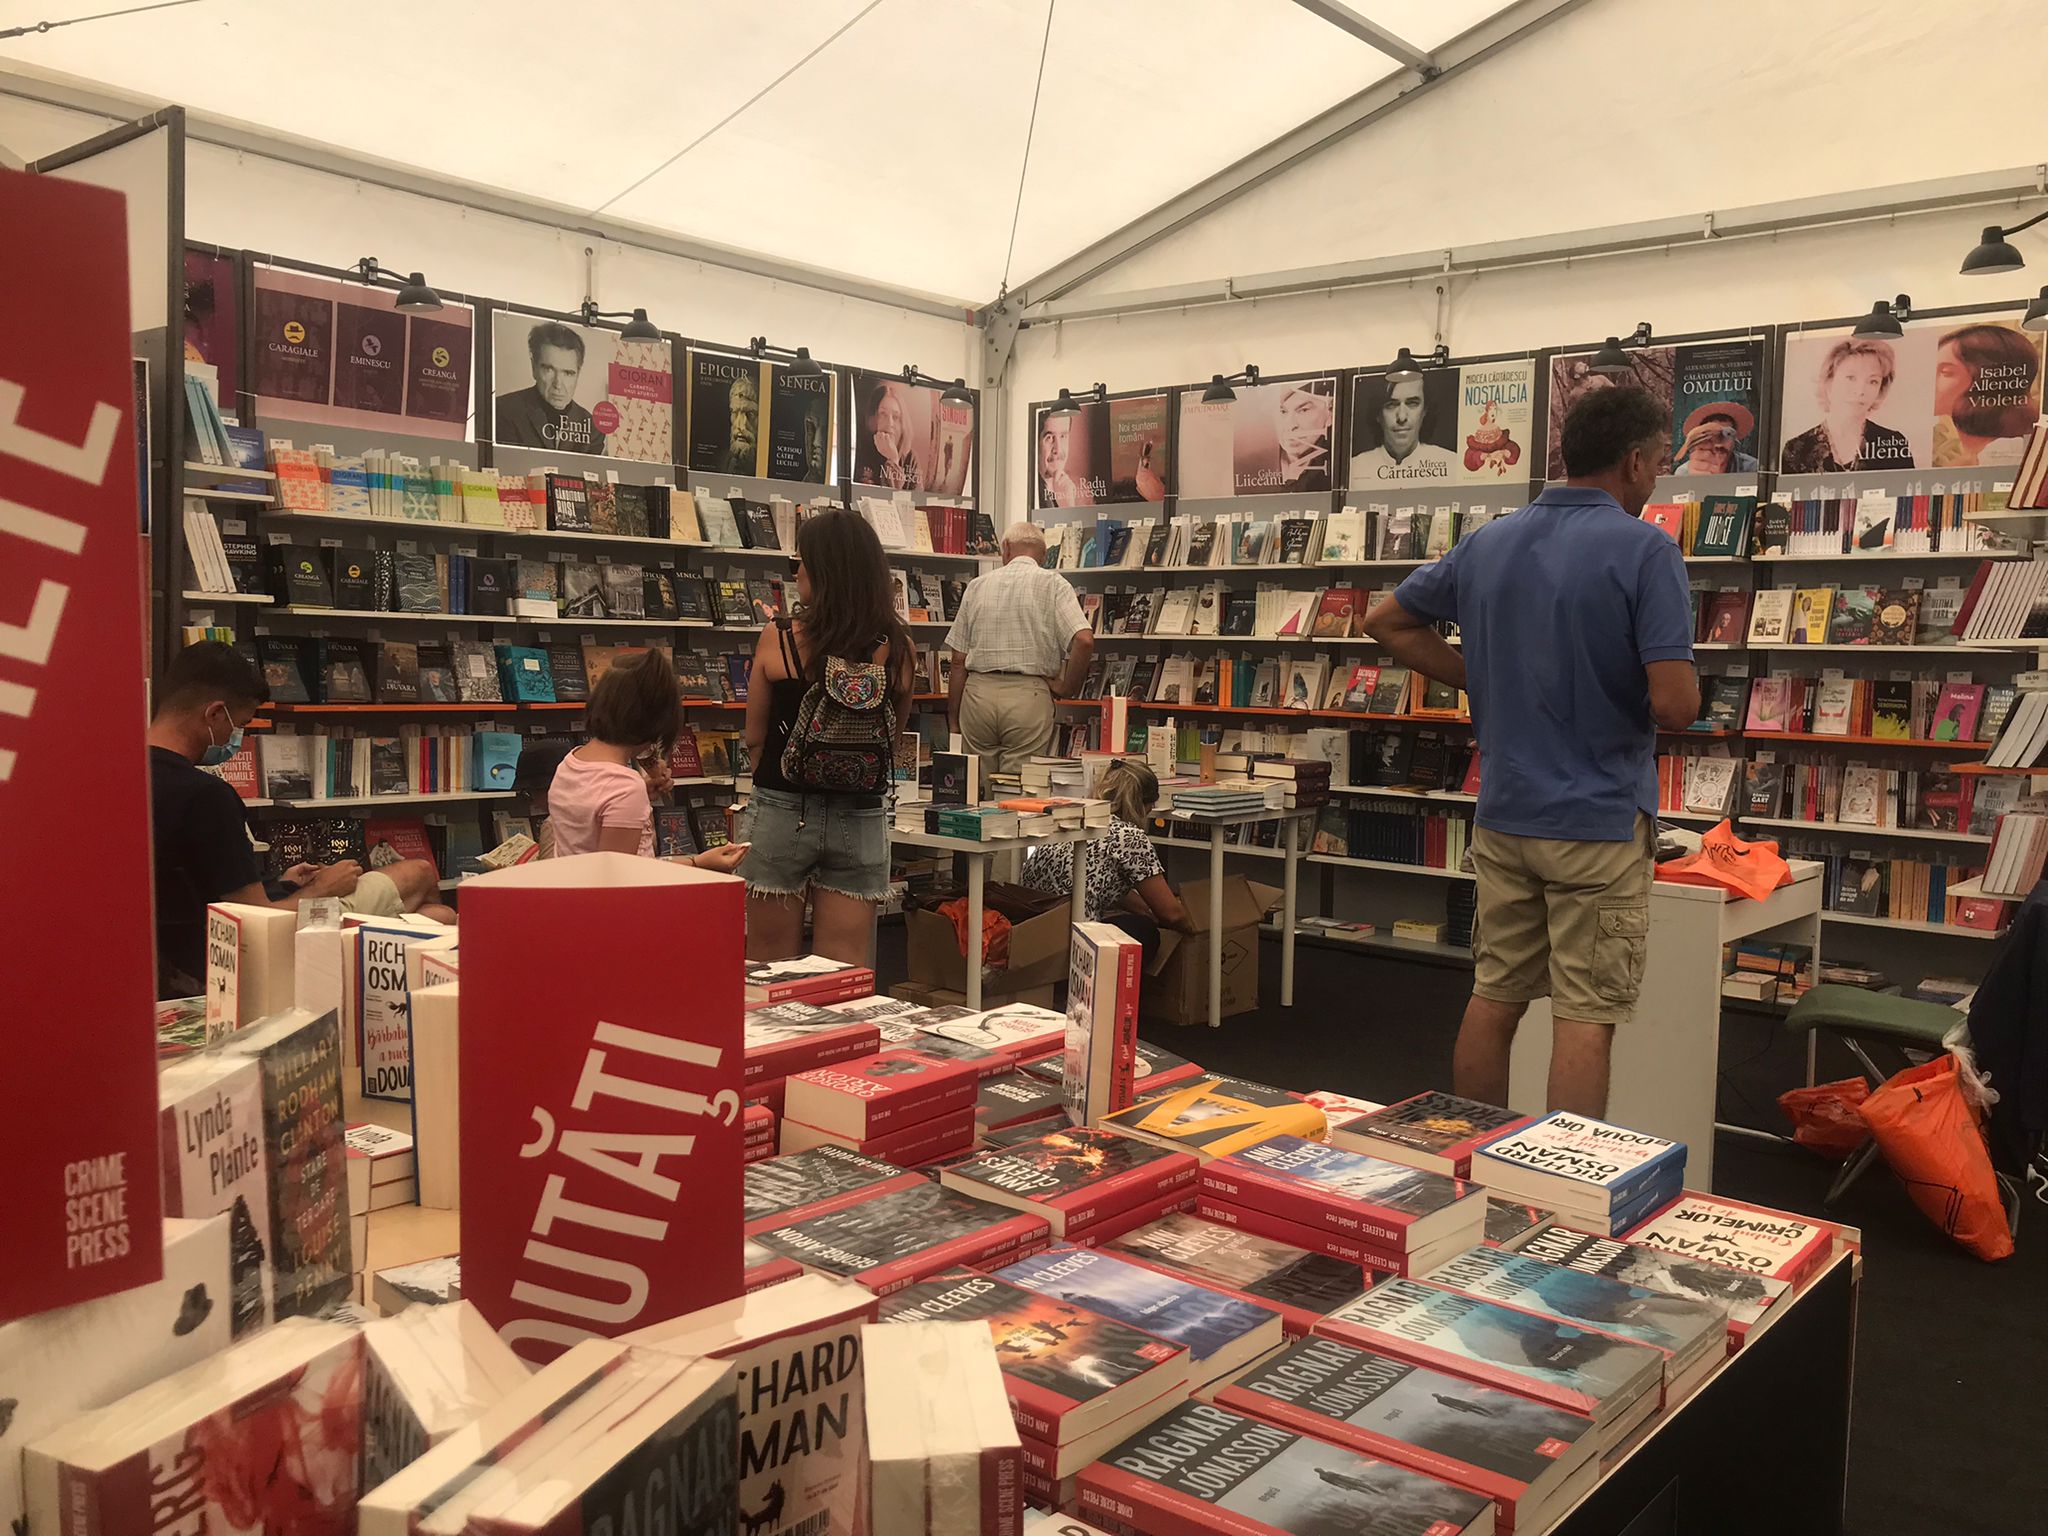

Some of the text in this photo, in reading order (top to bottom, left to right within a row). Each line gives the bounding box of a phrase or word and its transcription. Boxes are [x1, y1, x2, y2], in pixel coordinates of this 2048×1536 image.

[268, 342, 319, 358] CARAGIALE
[350, 355, 391, 370] EMINESCU
[618, 368, 664, 385] CIORAN
[700, 362, 749, 381] EPICUR
[779, 375, 826, 393] SENECA
[1465, 373, 1487, 385] MIRCEA
[1980, 363, 2027, 379] Isabel
[1465, 382, 1528, 406] NOSTALGIA
[1683, 377, 1752, 395] OMULUI
[1969, 378, 2029, 392] Allende
[1968, 393, 2029, 408] Violeta
[542, 423, 591, 444] Cioran
[559, 415, 591, 433] Emil
[1131, 421, 1158, 432] suntem
[1418, 459, 1447, 469] Mircea
[1857, 442, 1912, 460] Allend
[1080, 475, 1106, 489] Radu
[1377, 464, 1448, 480] Cărtărescu
[386, 683, 417, 692] DJUVARA
[220, 761, 253, 771] PRINTRE
[223, 770, 255, 781] ORMULE
[284, 844, 302, 853] 1001
[331, 839, 349, 847] 1001
[210, 942, 236, 974] OSMAN
[368, 965, 408, 992] OSM
[274, 1037, 337, 1090] HILLARY
[377, 1066, 410, 1093] DOU
[811, 1068, 893, 1093] ARION
[278, 1070, 340, 1124] RODHAM
[184, 1091, 233, 1159] Lynda
[279, 1096, 340, 1157] CLINTON
[209, 1132, 259, 1195] Plante
[1242, 1143, 1278, 1164] ANN
[1263, 1143, 1332, 1171] CLEEVES
[1510, 1140, 1620, 1173] OSMAN
[64, 1151, 128, 1197] CRIME
[299, 1150, 329, 1186] STARE
[979, 1157, 1061, 1188] CLEEVES
[988, 1172, 1038, 1192] ANN
[65, 1186, 128, 1233] SCENE
[66, 1223, 130, 1270] PRESS
[773, 1227, 879, 1271] GEORGE ARION
[1140, 1227, 1182, 1252] ANN
[1162, 1226, 1237, 1262] CLEEVES
[1647, 1231, 1772, 1272] OSMAN
[1038, 1251, 1099, 1284] CLEEVES
[1426, 1245, 1511, 1289] RAGNAR
[927, 1277, 996, 1320] CLEEVES
[1339, 1279, 1435, 1331] RAGNAR
[738, 1333, 858, 1420] HARD
[1247, 1338, 1363, 1402] RAGNAR
[1318, 1354, 1411, 1419] JÓNASSON
[740, 1392, 849, 1481] MAN
[1116, 1403, 1246, 1481] RAGNAR
[1178, 1423, 1296, 1499] JÓNASSON
